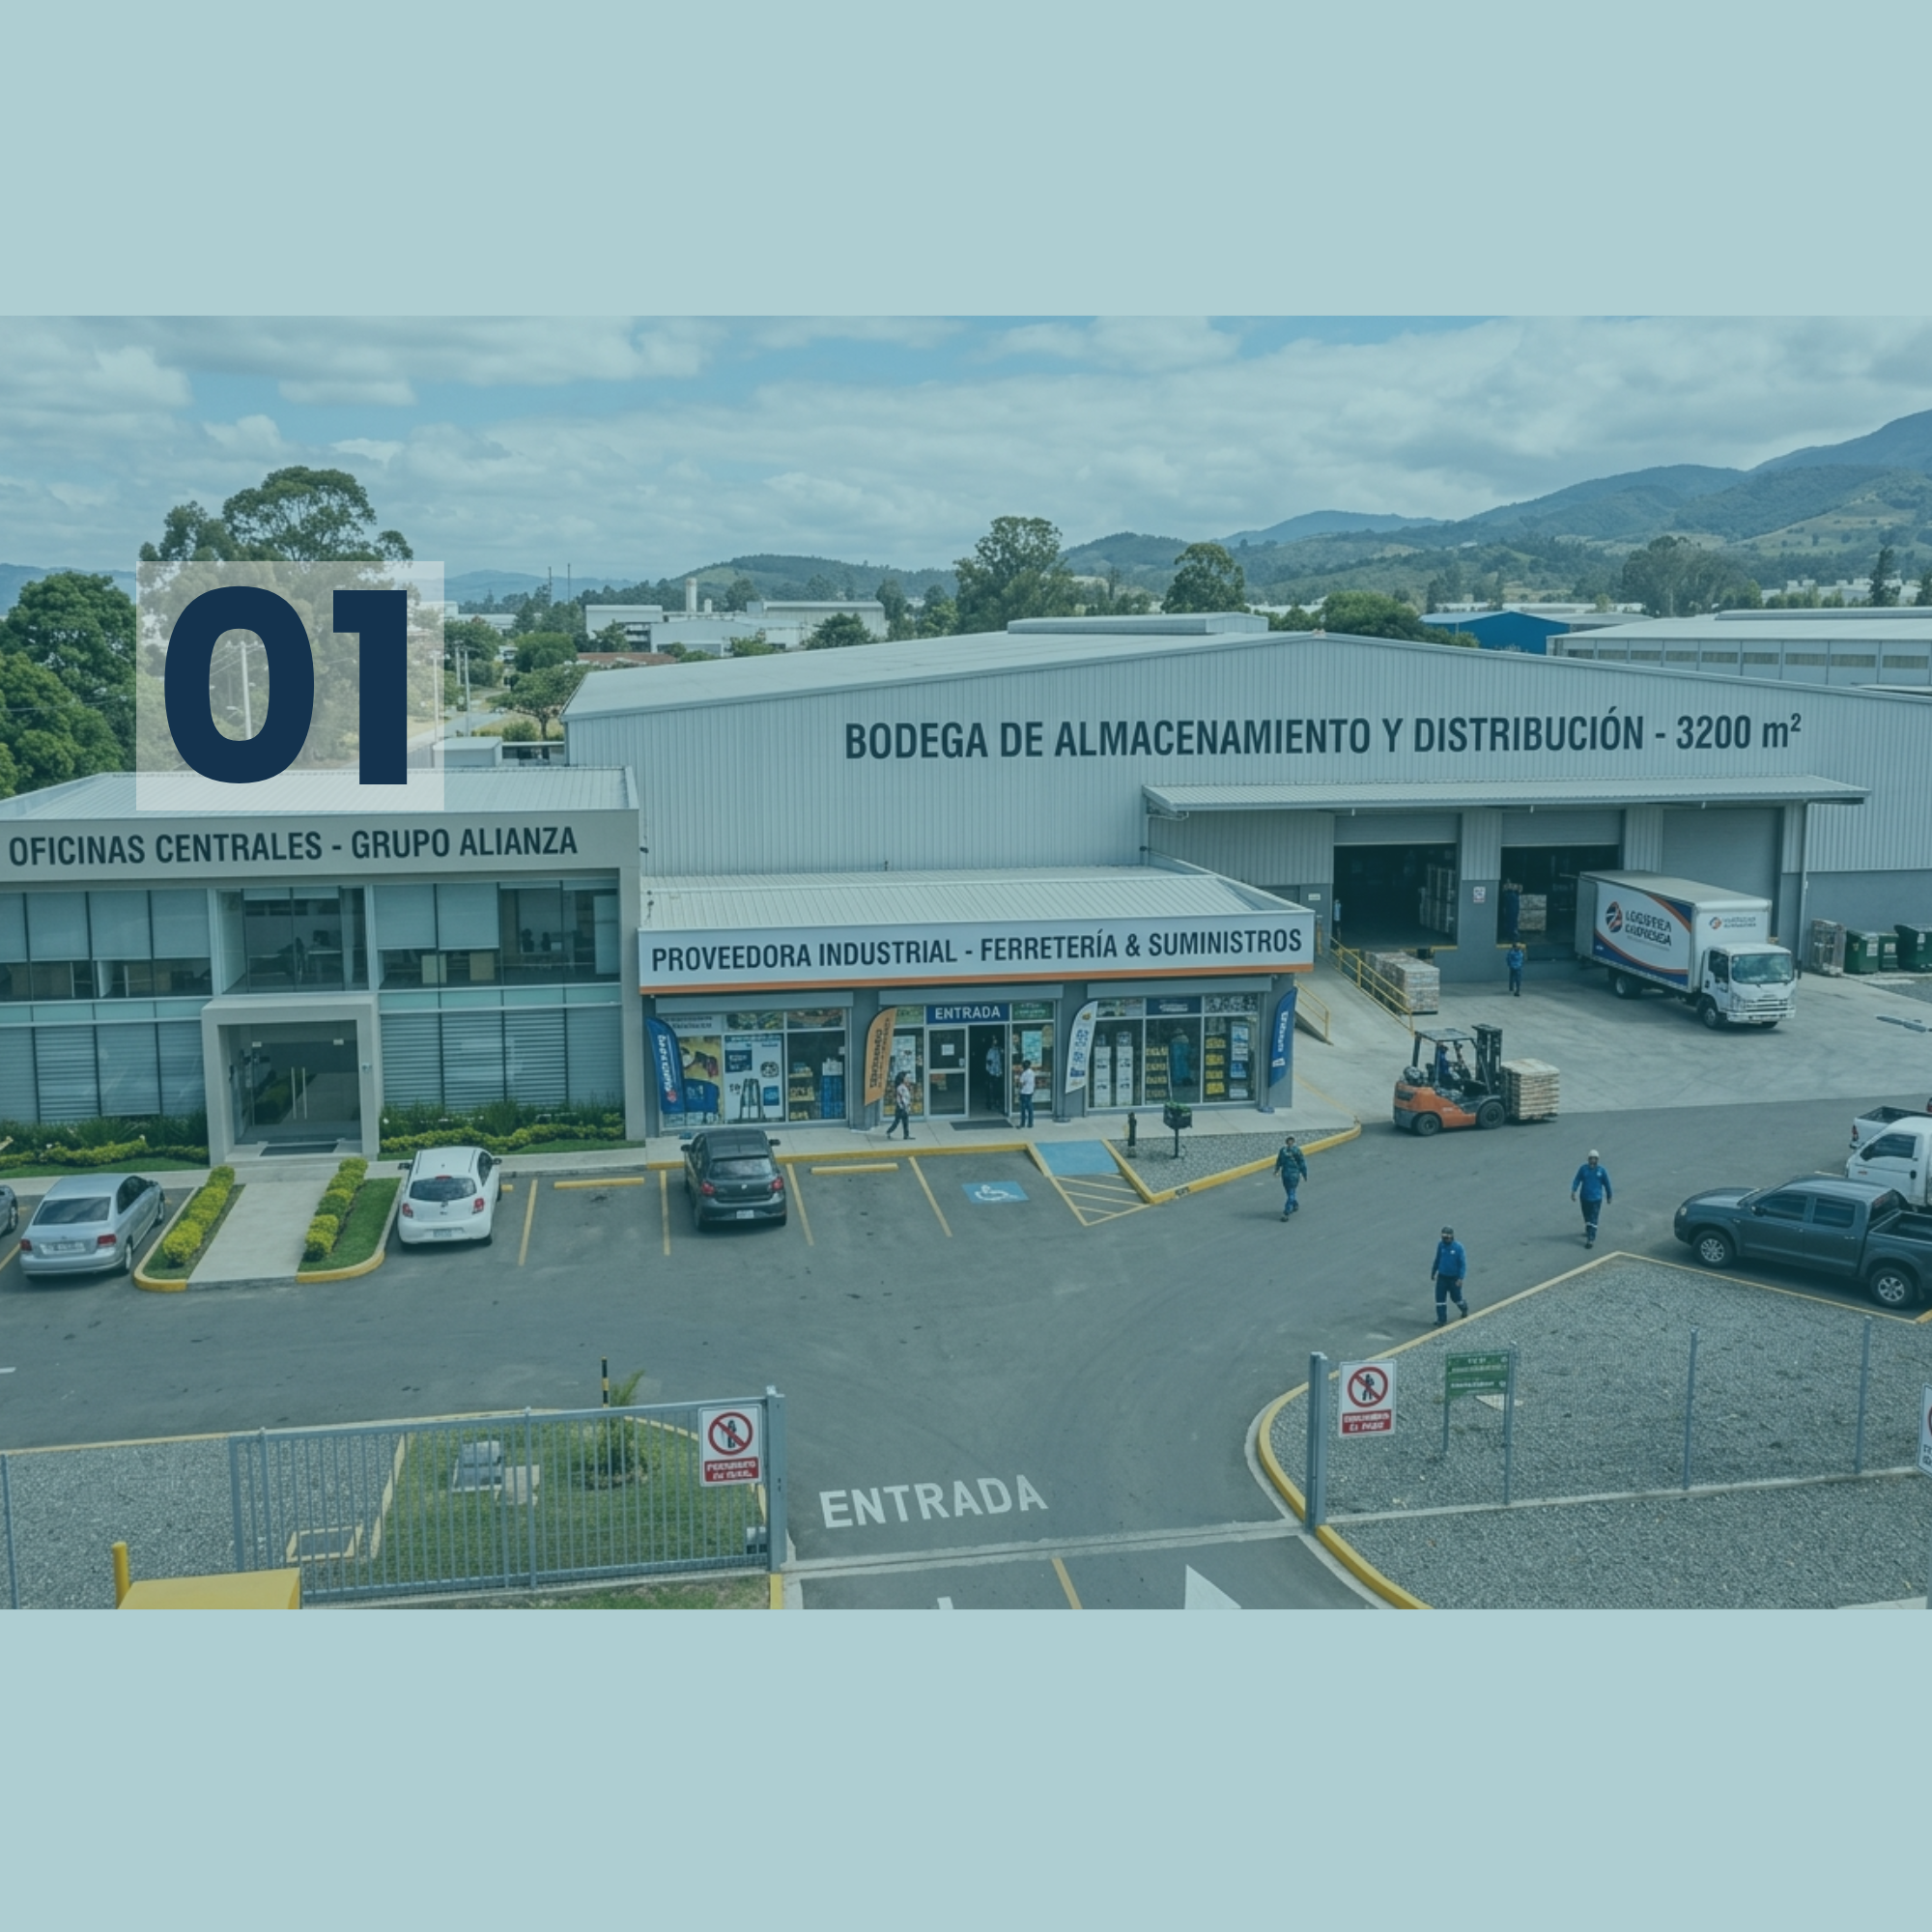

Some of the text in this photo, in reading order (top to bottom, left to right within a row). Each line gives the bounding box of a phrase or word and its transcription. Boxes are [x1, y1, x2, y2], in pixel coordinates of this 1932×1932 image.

[846, 723, 988, 758] BODEGA
[1001, 722, 1042, 756] DE
[1055, 719, 1370, 755] ALMACENAMIENTO
[1382, 719, 1403, 753] Y
[1415, 706, 1644, 752] DISTRIBUCIÓN
[1676, 715, 1750, 749] 3200
[10, 835, 145, 866] OFICINAS
[156, 832, 322, 863] CENTRALES
[352, 829, 449, 859] GRUPO
[460, 827, 577, 856] ALIANZA
[652, 944, 811, 972] PROVEEDORA
[819, 940, 957, 967] INDUSTRIAL
[980, 928, 1118, 961] FERRETERÍA
[1125, 934, 1141, 956] &
[1149, 928, 1302, 956] SUMINISTROS
[935, 1006, 1001, 1020] ENTRADA
[819, 1474, 1048, 1528] ENTRADA
